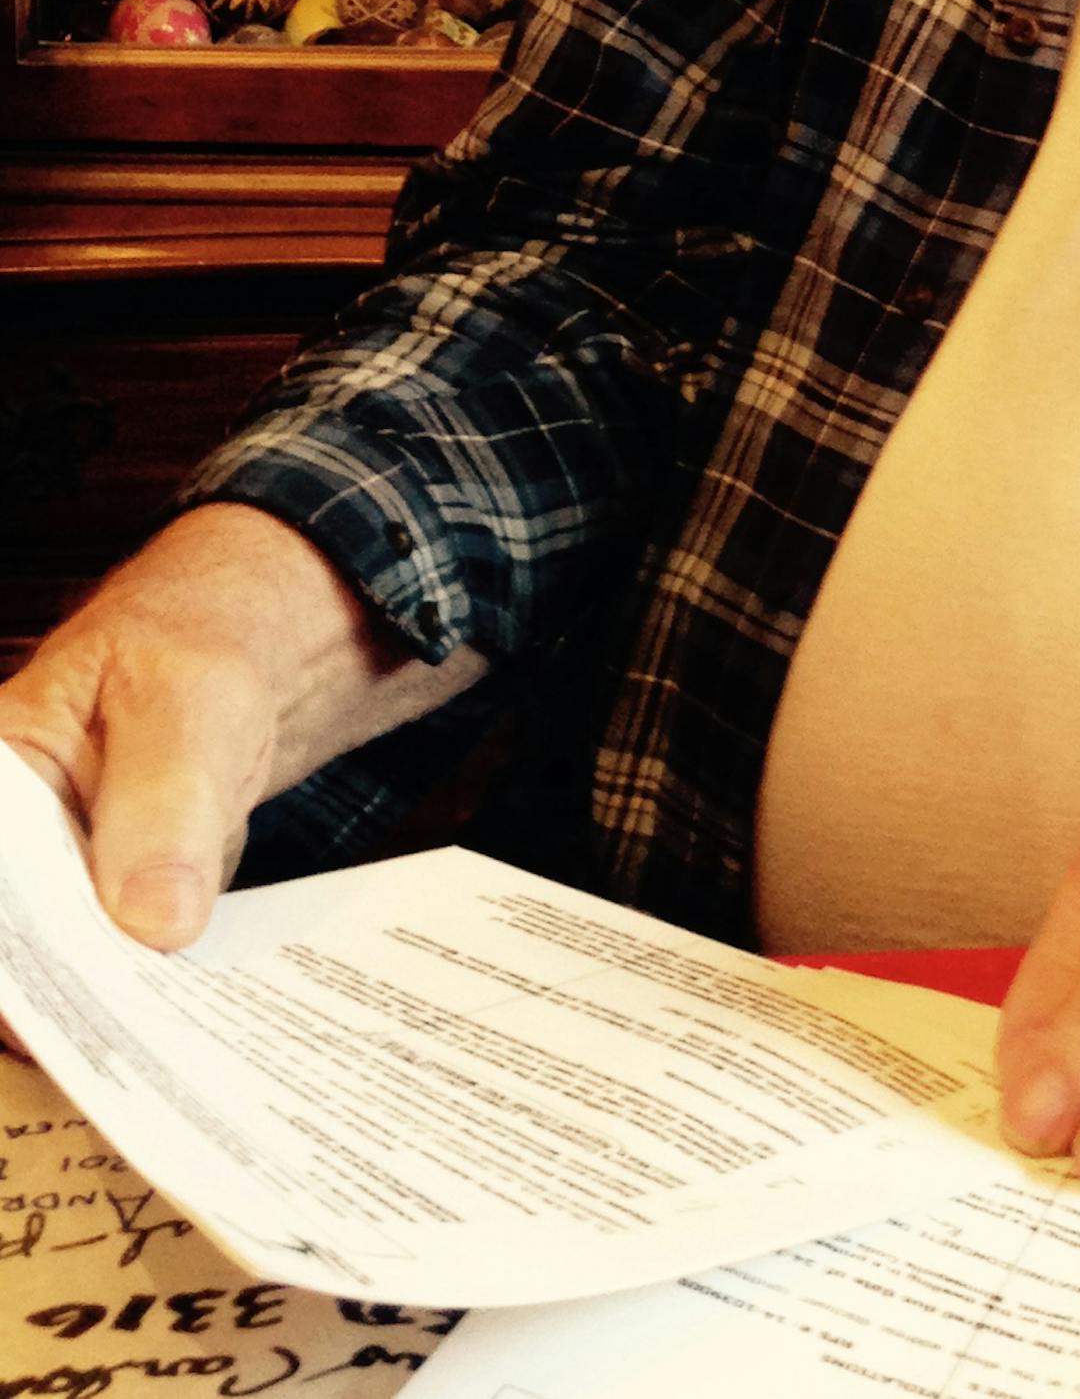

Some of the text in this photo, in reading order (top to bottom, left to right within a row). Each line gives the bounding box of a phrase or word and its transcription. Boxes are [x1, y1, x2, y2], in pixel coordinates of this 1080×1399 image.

[855, 1277, 896, 1301] date
[25, 1285, 286, 1339] 3316
[905, 1295, 938, 1316] due
[943, 1308, 1025, 1346] required
[1032, 1337, 1063, 1357] the
